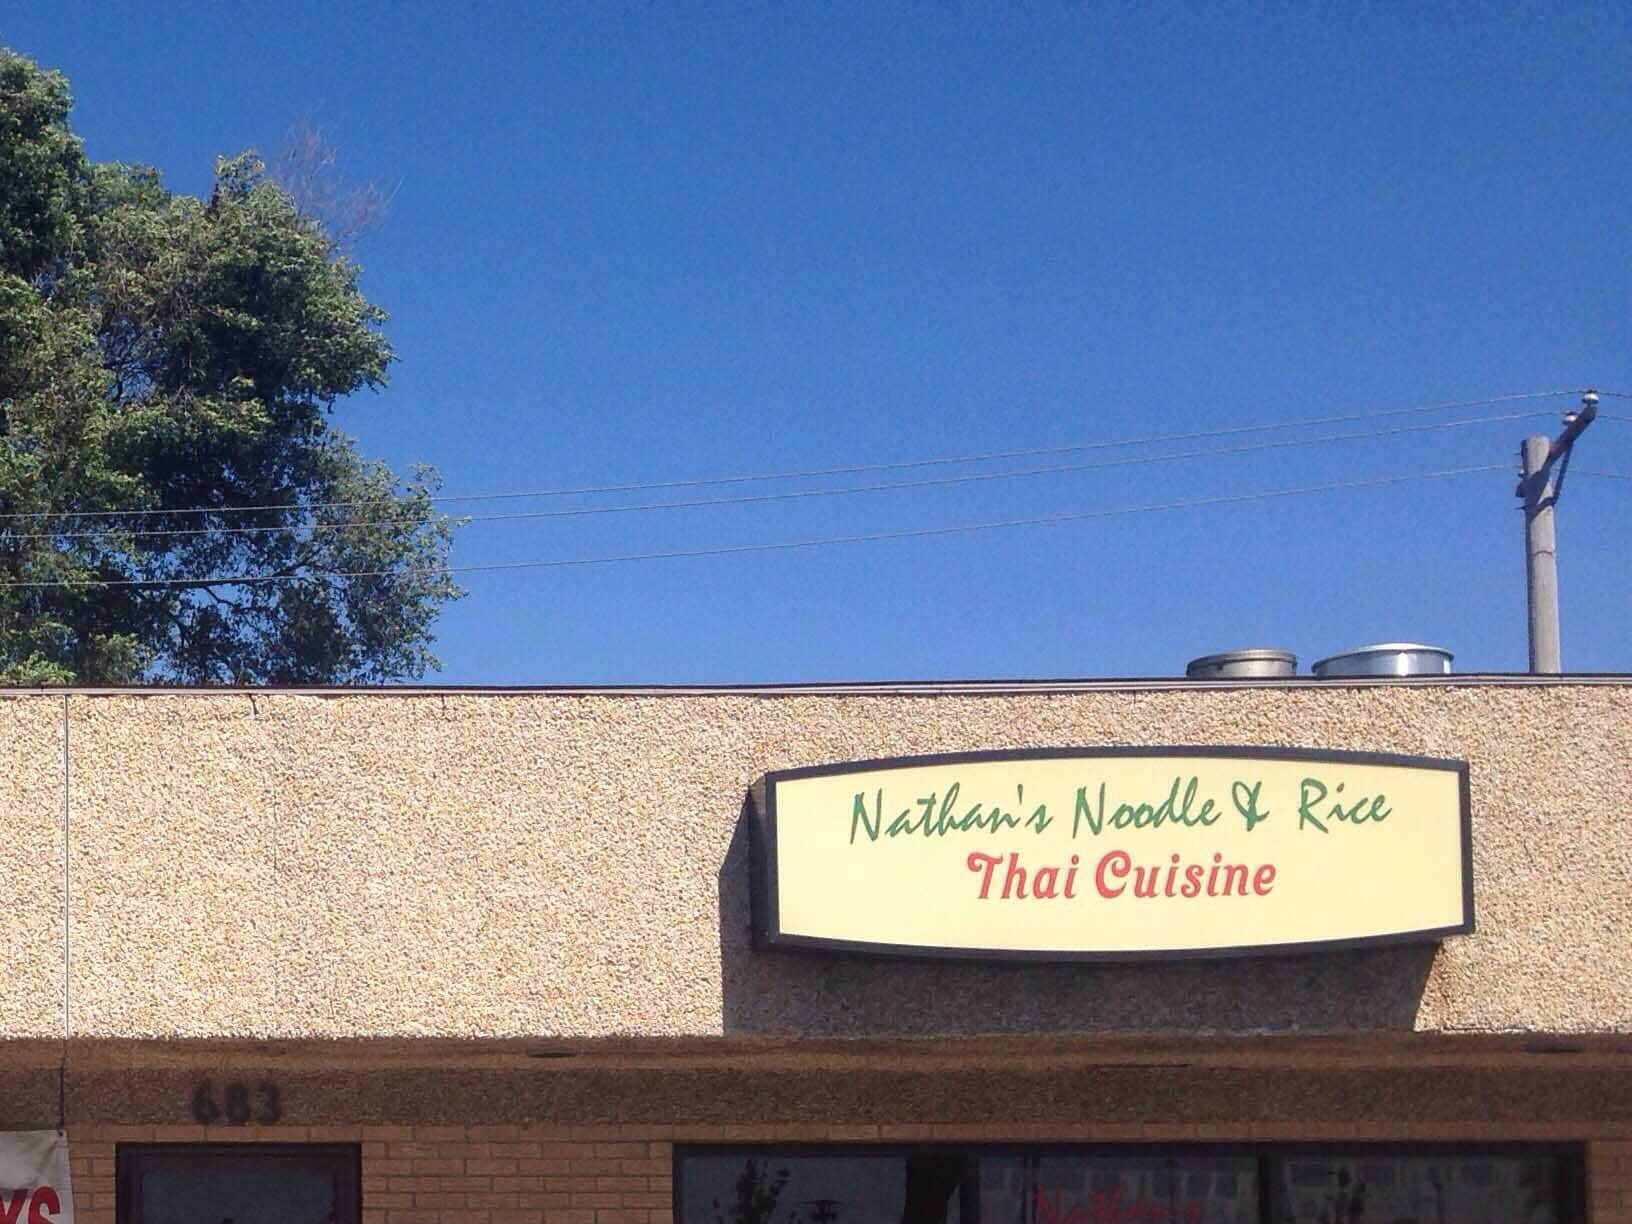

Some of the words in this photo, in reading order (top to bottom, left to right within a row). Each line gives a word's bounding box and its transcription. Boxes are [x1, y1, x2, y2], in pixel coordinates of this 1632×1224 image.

[849, 782, 1053, 845] Nathan's
[1072, 778, 1222, 839] Noodle
[1232, 780, 1269, 832] &
[1298, 778, 1393, 834] Rice
[967, 851, 1079, 900] Thai
[1095, 850, 1276, 898] Cuisine
